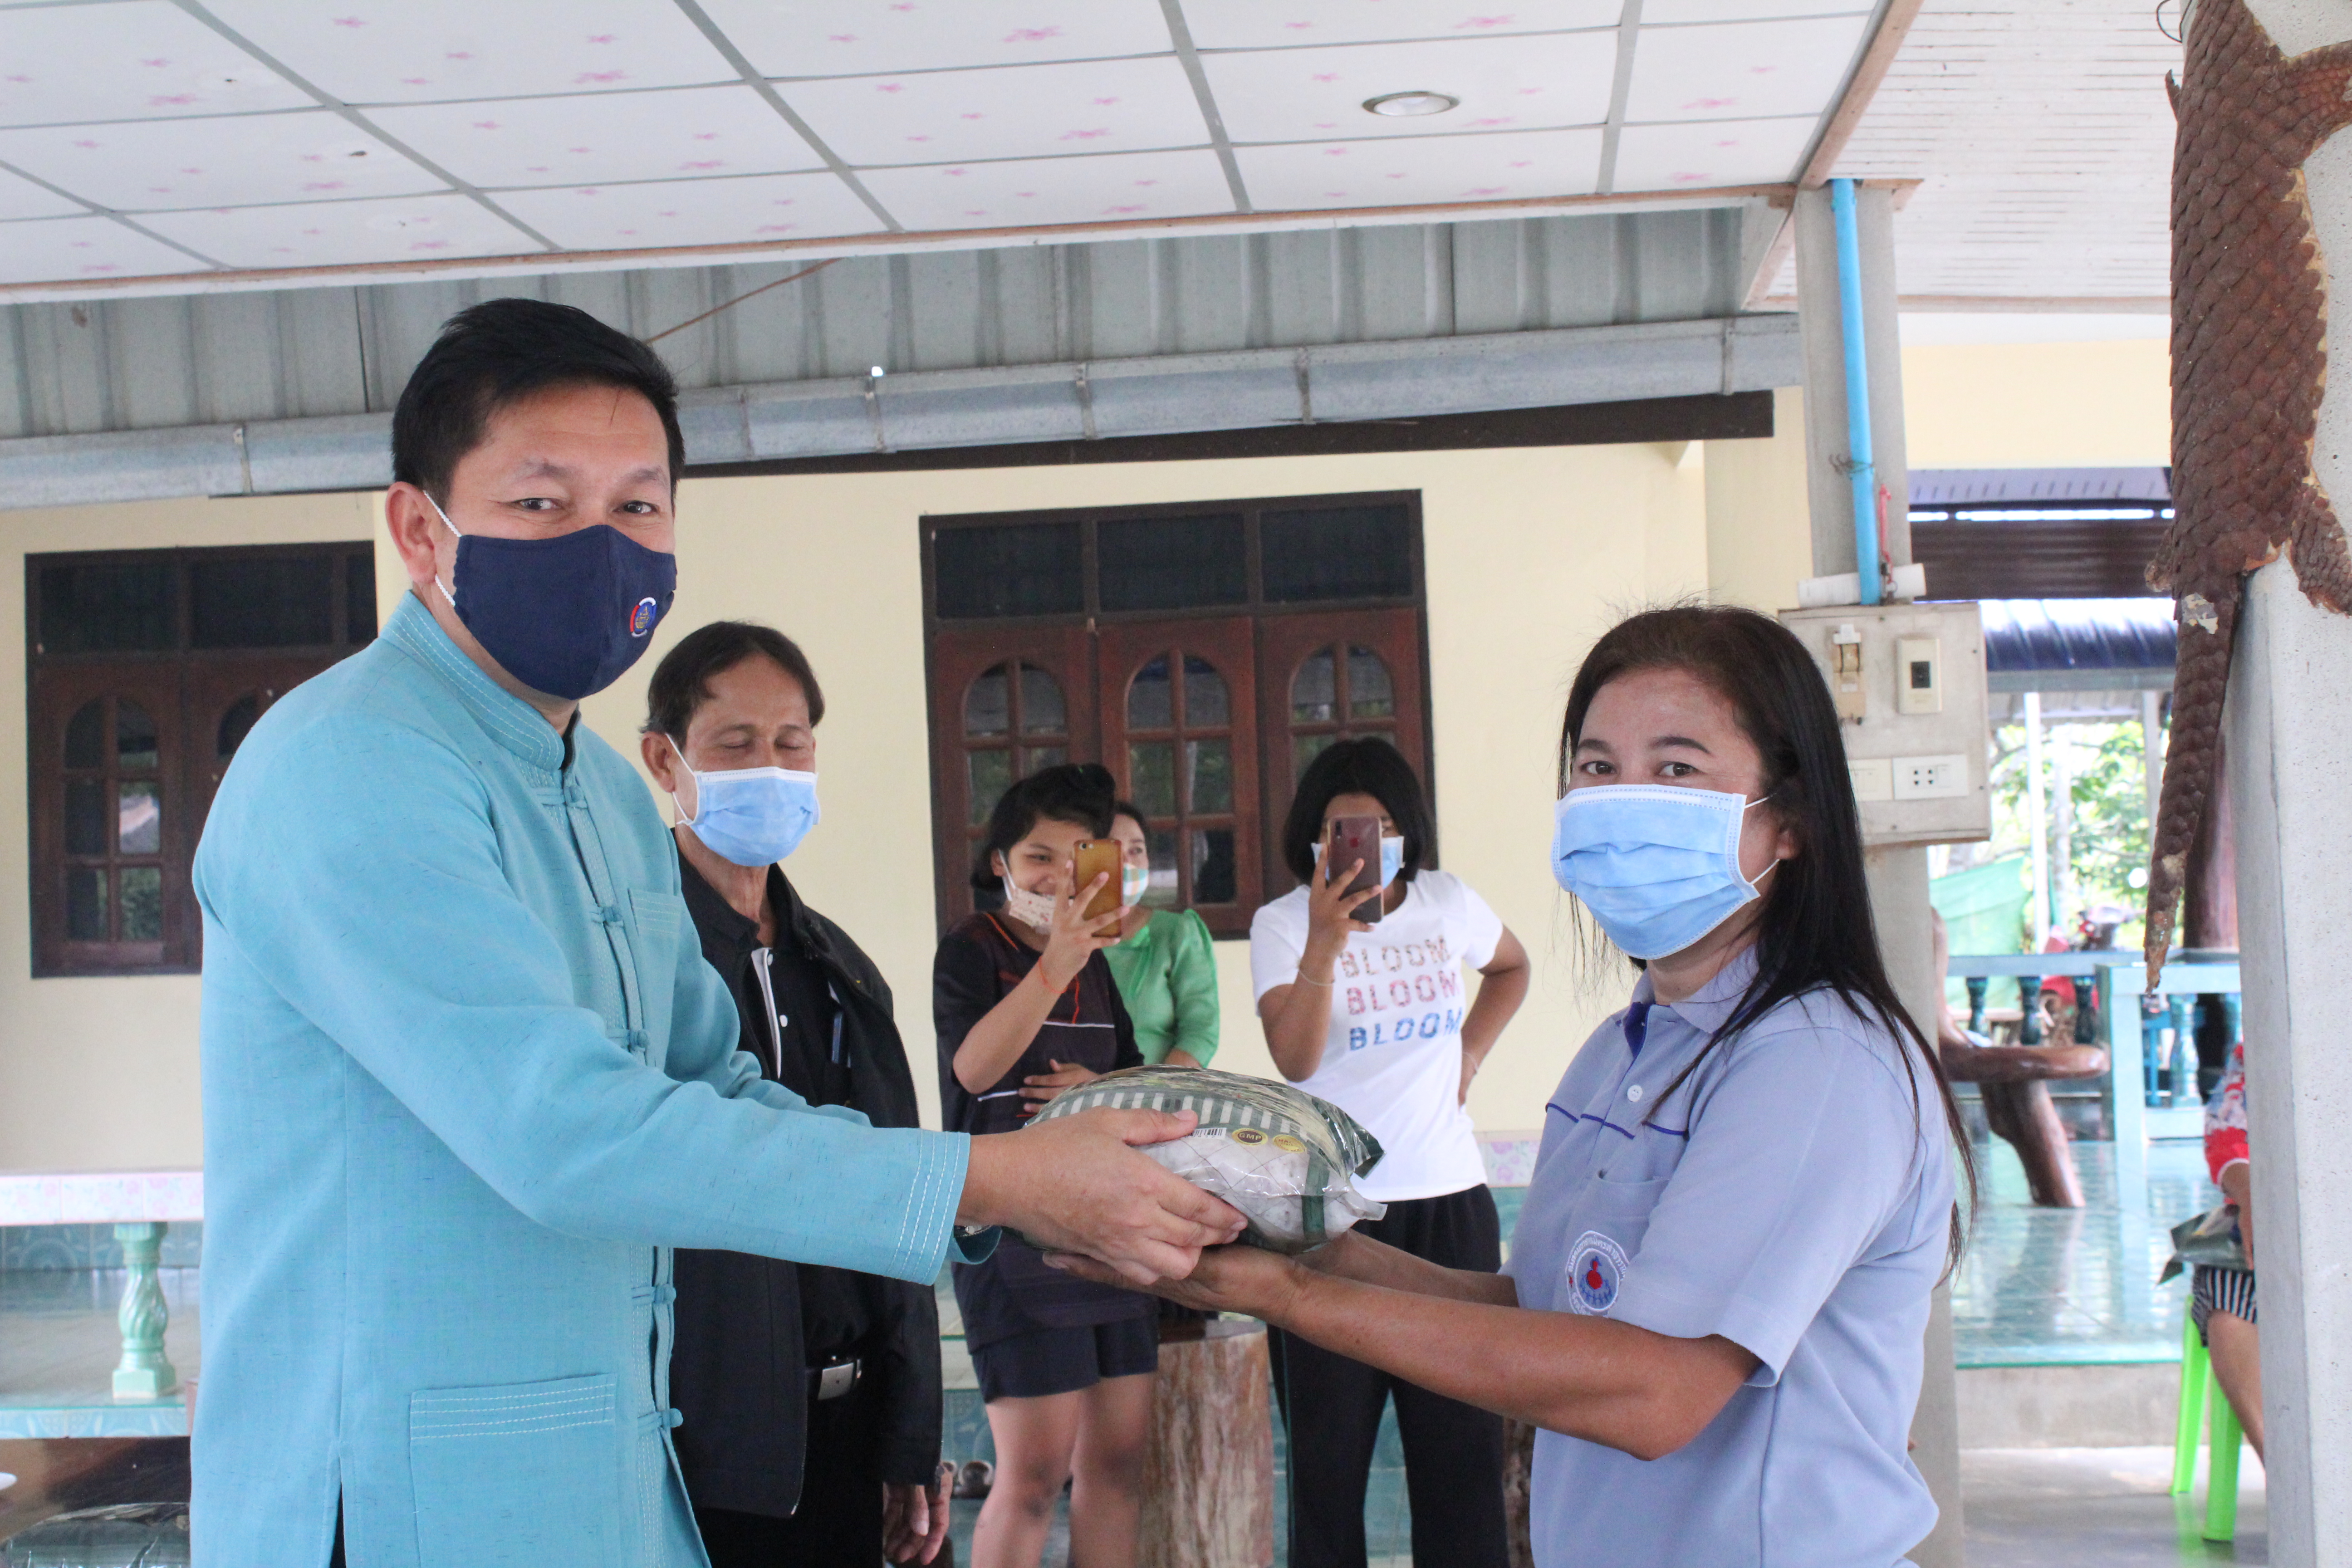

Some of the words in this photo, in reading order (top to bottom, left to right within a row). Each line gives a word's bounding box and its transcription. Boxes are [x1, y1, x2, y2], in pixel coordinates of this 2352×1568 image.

[1340, 935, 1450, 978] BLOOM
[1347, 970, 1460, 1015] BLOOM
[1350, 1007, 1462, 1051] BLOOM
